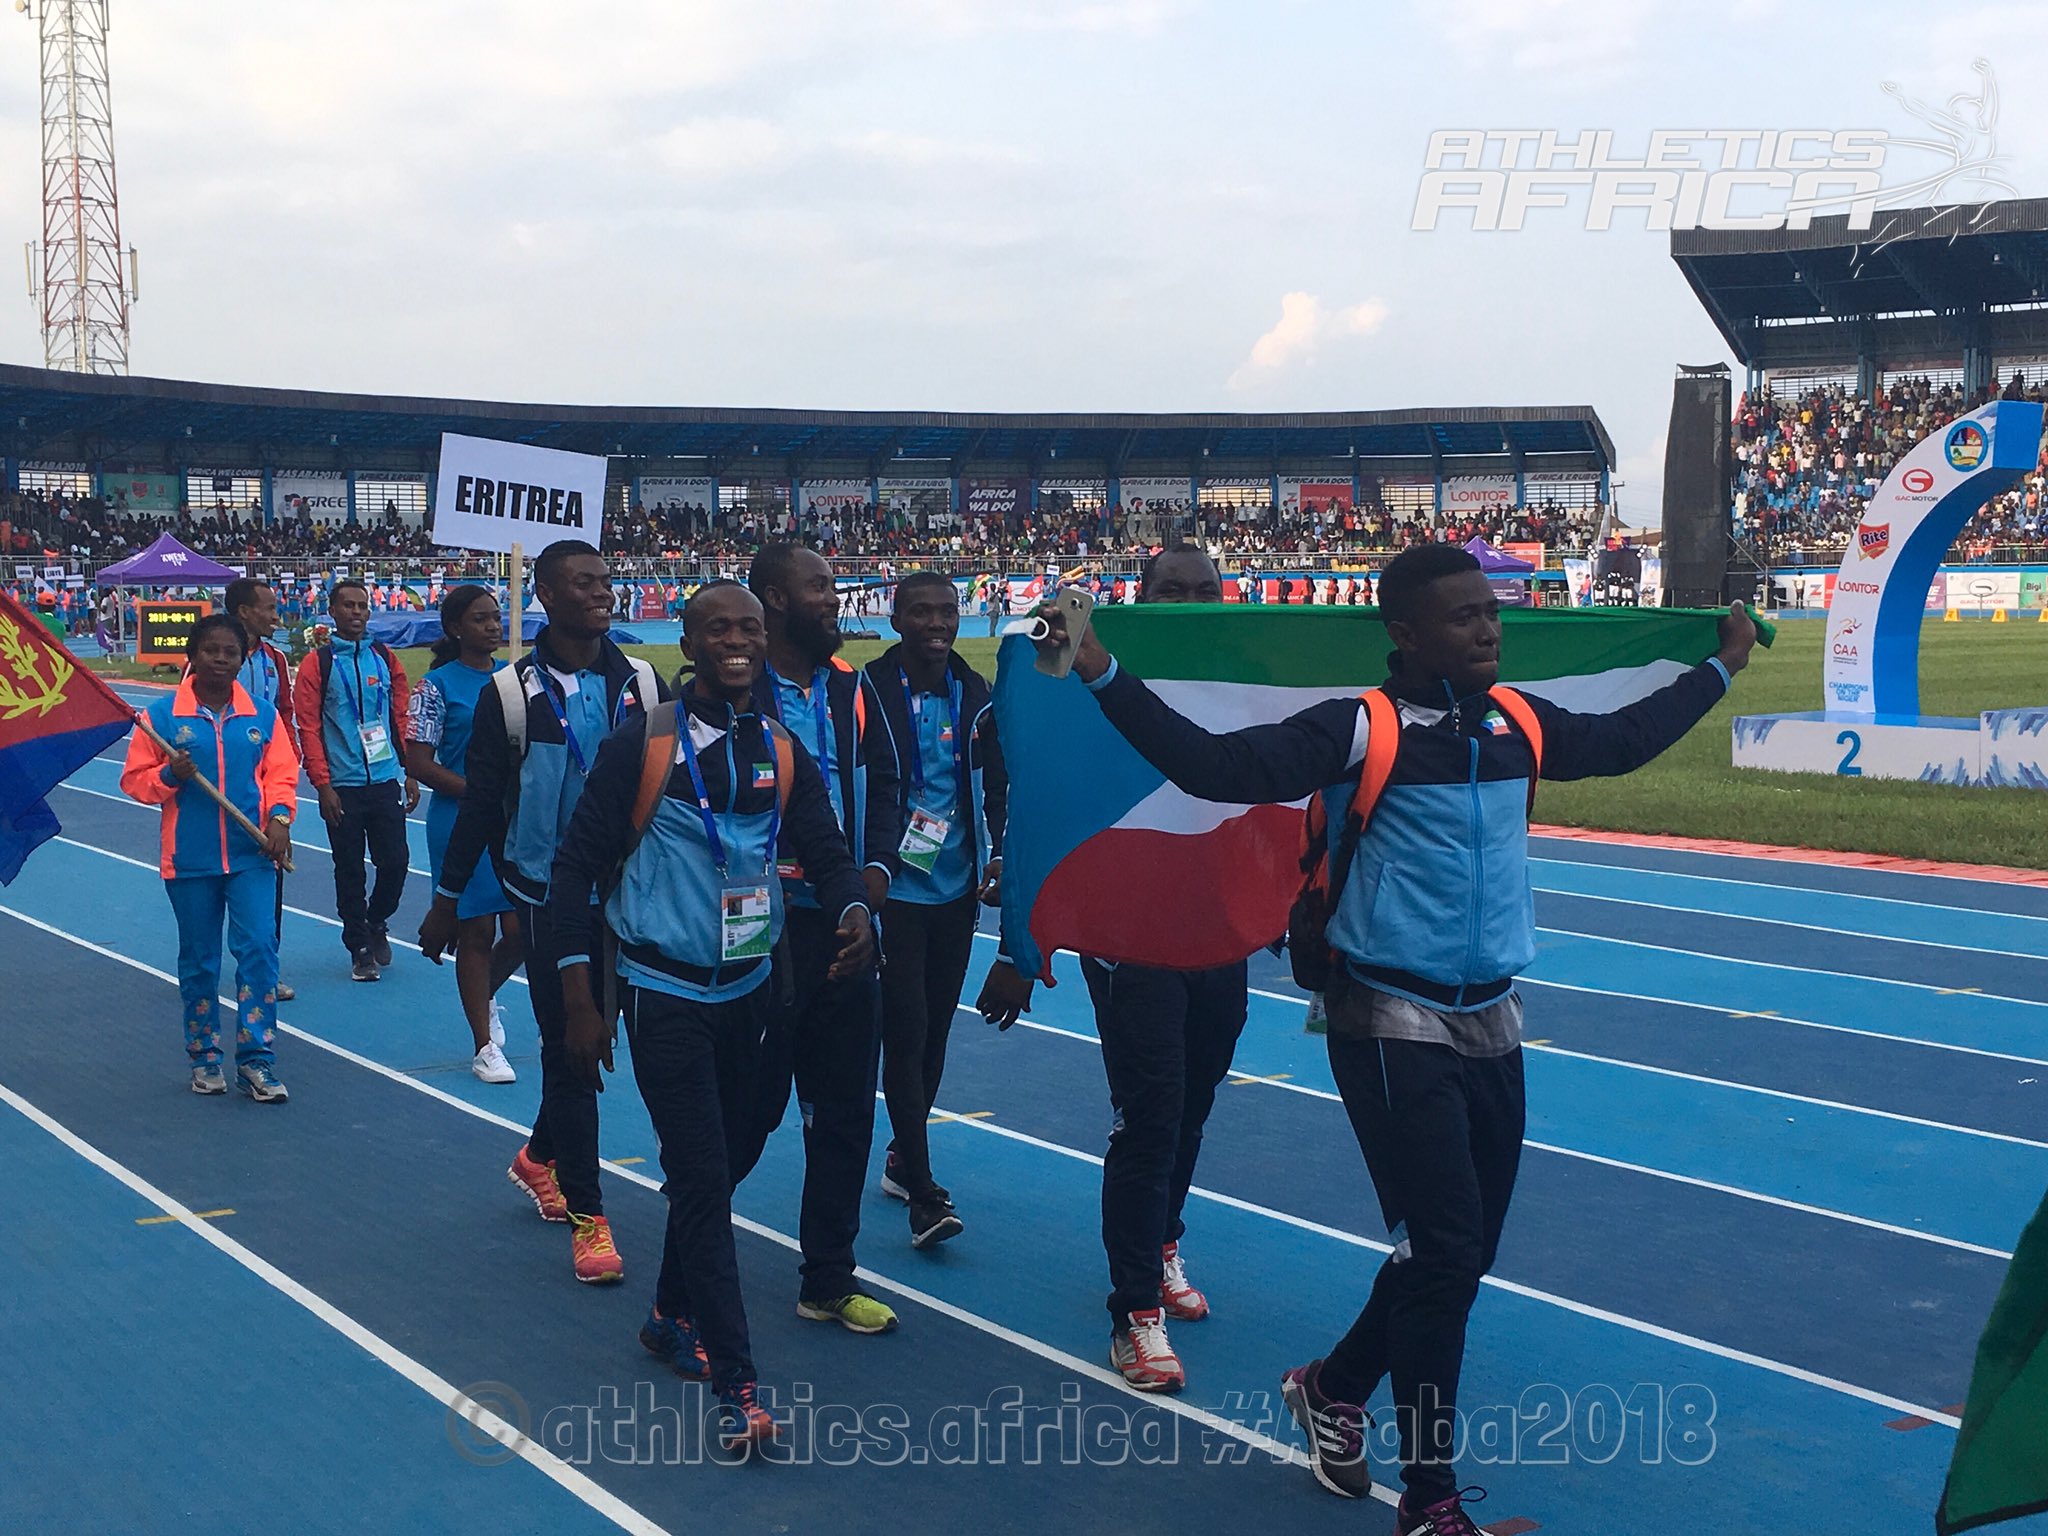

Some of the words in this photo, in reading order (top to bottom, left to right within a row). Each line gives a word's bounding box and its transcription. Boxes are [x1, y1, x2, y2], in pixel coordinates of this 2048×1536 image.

[18, 460, 87, 472] #ASABA2018
[276, 470, 342, 480] #ASABA2018
[641, 478, 672, 486] AFRICA
[674, 478, 688, 486] WA
[803, 480, 867, 488] #ASABA2018
[1042, 479, 1106, 488] #ASABA2018
[1120, 478, 1152, 486] AFRICA
[1153, 478, 1169, 486] WA
[1206, 478, 1269, 486] #ASABA2018
[969, 489, 1017, 500] AFRICA
[1450, 490, 1509, 502] LONTOR
[455, 474, 584, 529] ERITREA
[969, 501, 989, 512] WA
[1861, 530, 1888, 547] Rite
[1838, 581, 1880, 595] LONTOR
[1833, 643, 1858, 657] CAA
[1836, 729, 1862, 776] 2
